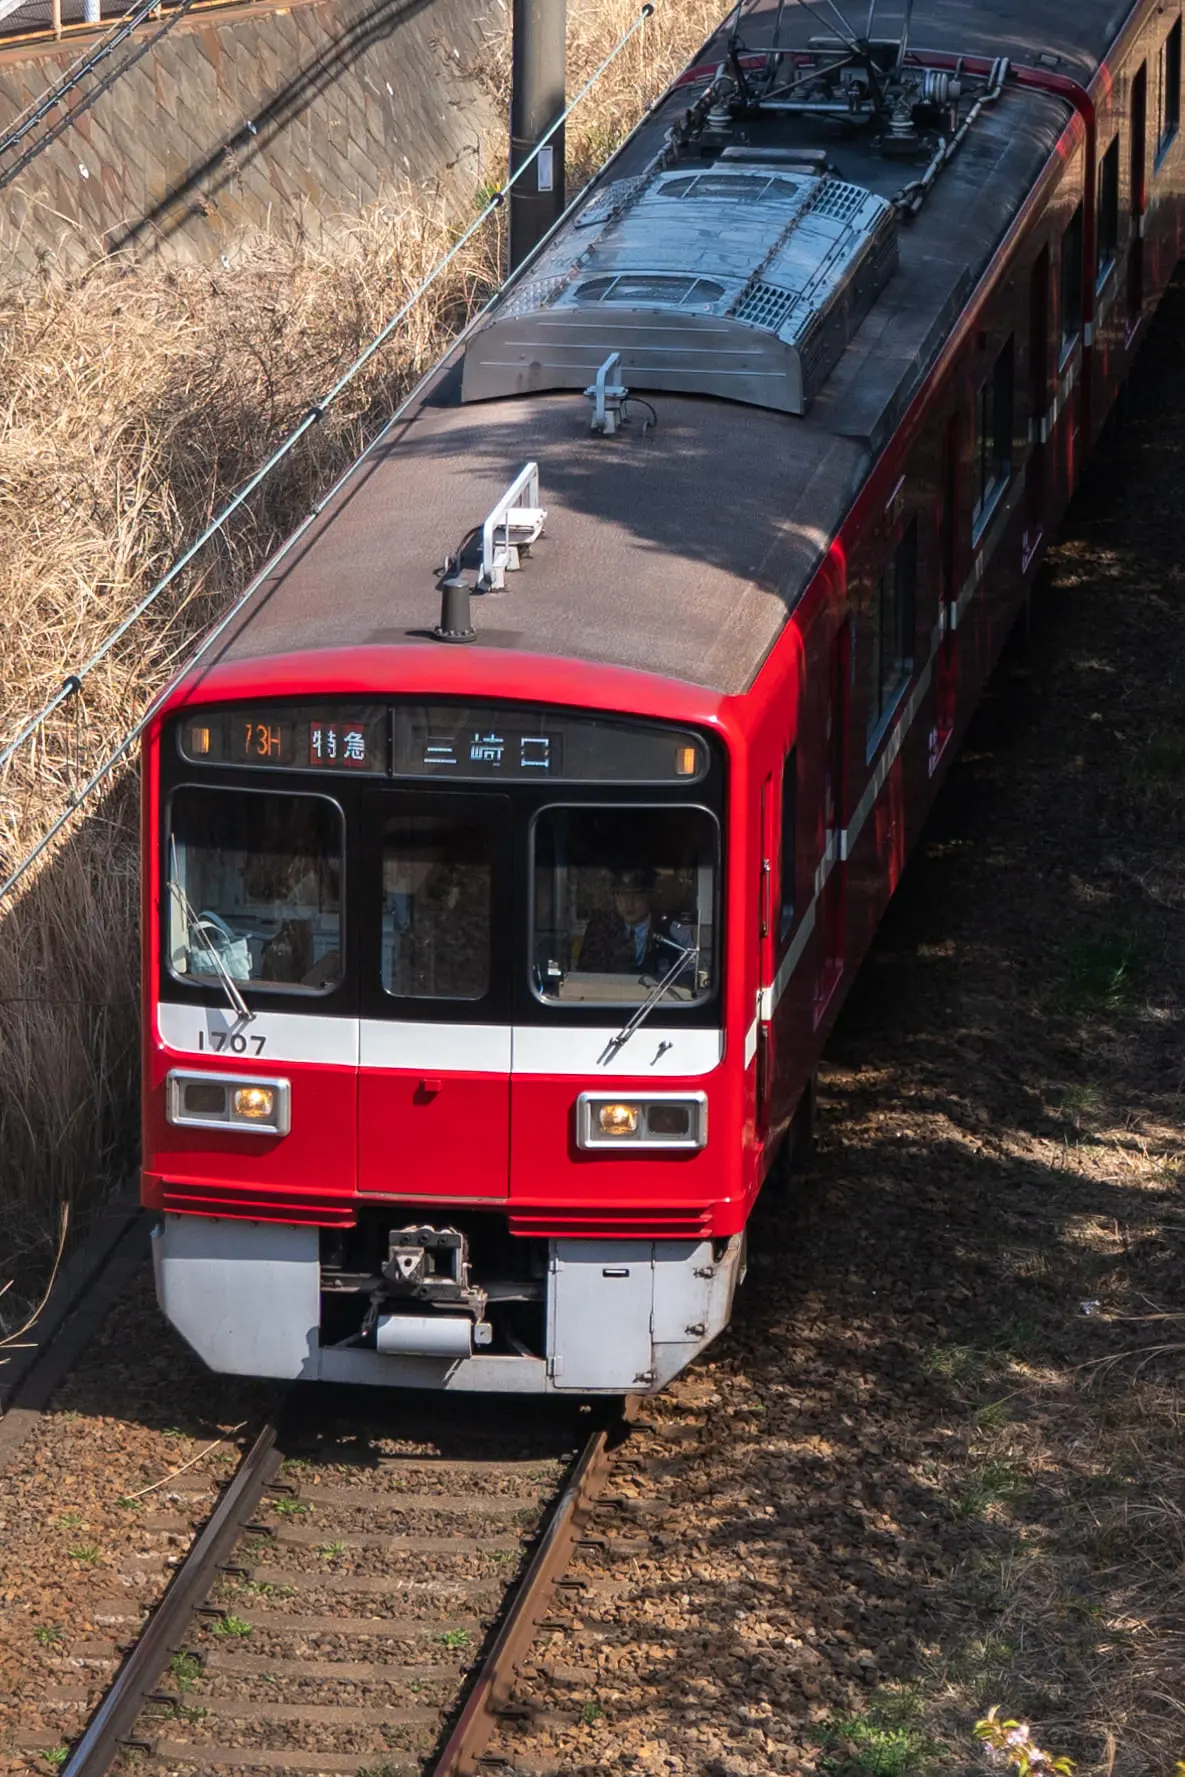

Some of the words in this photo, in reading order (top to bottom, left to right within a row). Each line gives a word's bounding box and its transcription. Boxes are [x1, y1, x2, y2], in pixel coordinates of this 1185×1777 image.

[244, 723, 282, 757] 73H
[312, 729, 366, 761] 特急
[198, 1030, 267, 1056] 1707
